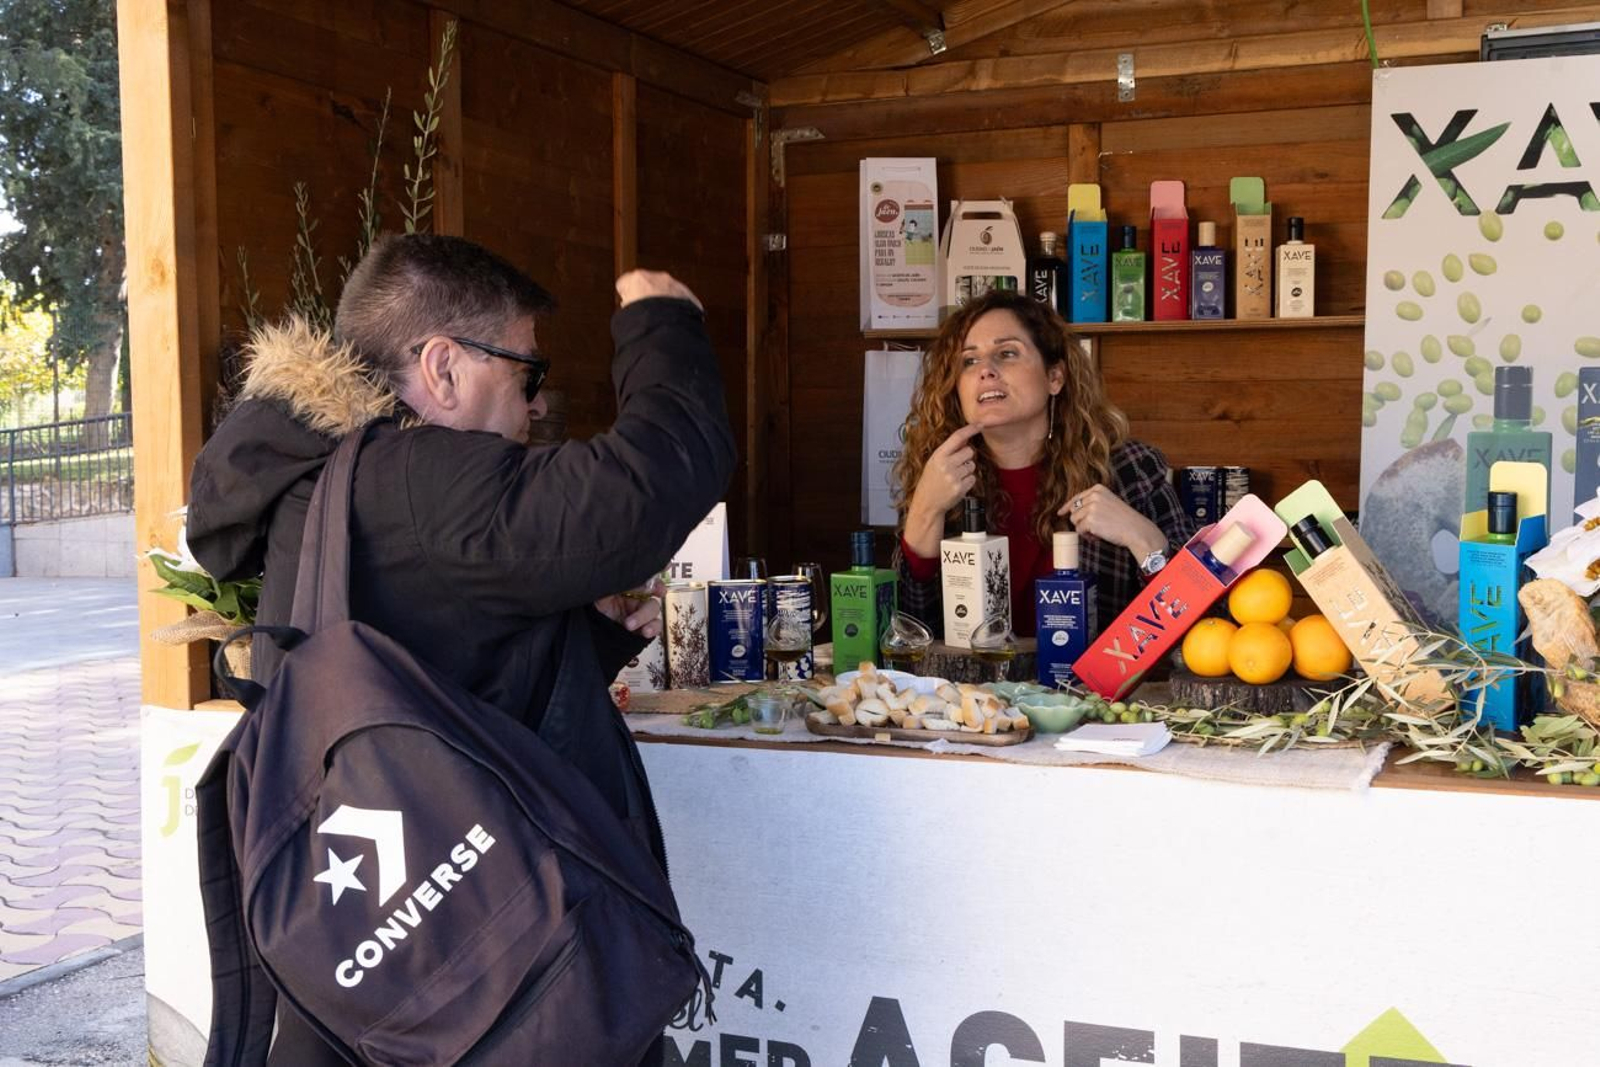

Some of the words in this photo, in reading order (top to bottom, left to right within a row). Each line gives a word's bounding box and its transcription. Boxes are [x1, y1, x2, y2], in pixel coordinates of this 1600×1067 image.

[1381, 102, 1600, 219] XA
[1194, 255, 1222, 265] XAVE
[1283, 250, 1312, 261] XAVE
[1081, 244, 1099, 301] XAVE
[1161, 241, 1181, 301] XAVE
[1581, 382, 1600, 404] X
[1188, 471, 1217, 482] XAVE
[943, 550, 976, 566] XAVE
[719, 590, 758, 604] XAVE
[834, 583, 868, 599] XAVE
[1039, 589, 1082, 605] XAVE
[1102, 583, 1189, 676] XAVE
[335, 824, 496, 988] CONVERSE
